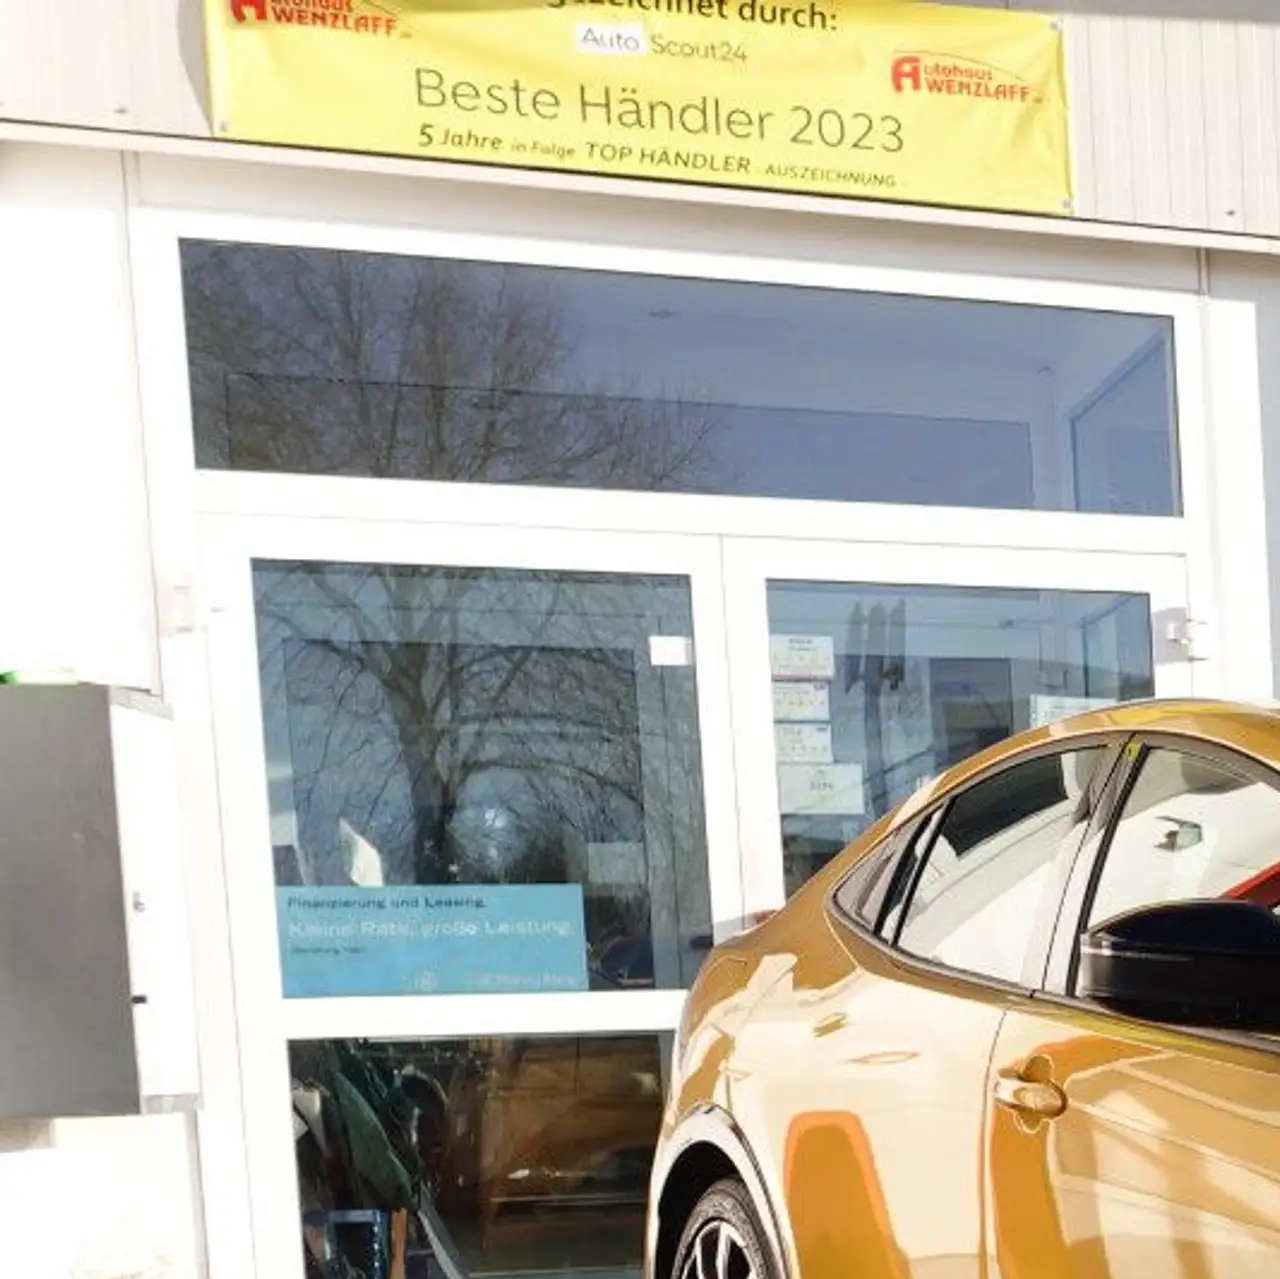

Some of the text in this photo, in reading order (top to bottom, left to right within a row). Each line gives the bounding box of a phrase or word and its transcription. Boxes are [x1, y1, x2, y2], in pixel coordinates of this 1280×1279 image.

[271, 7, 396, 36] WENZLAFF
[738, 2, 838, 31] durch:
[580, 26, 748, 63] Auto Scout24
[924, 77, 1030, 103] WENZLAFF
[415, 67, 904, 152] Beste Händler 2023
[418, 122, 434, 147] 5
[440, 127, 504, 150] Jahre
[586, 141, 632, 162] TOP
[765, 164, 897, 187] AUSZEICHNUNG
